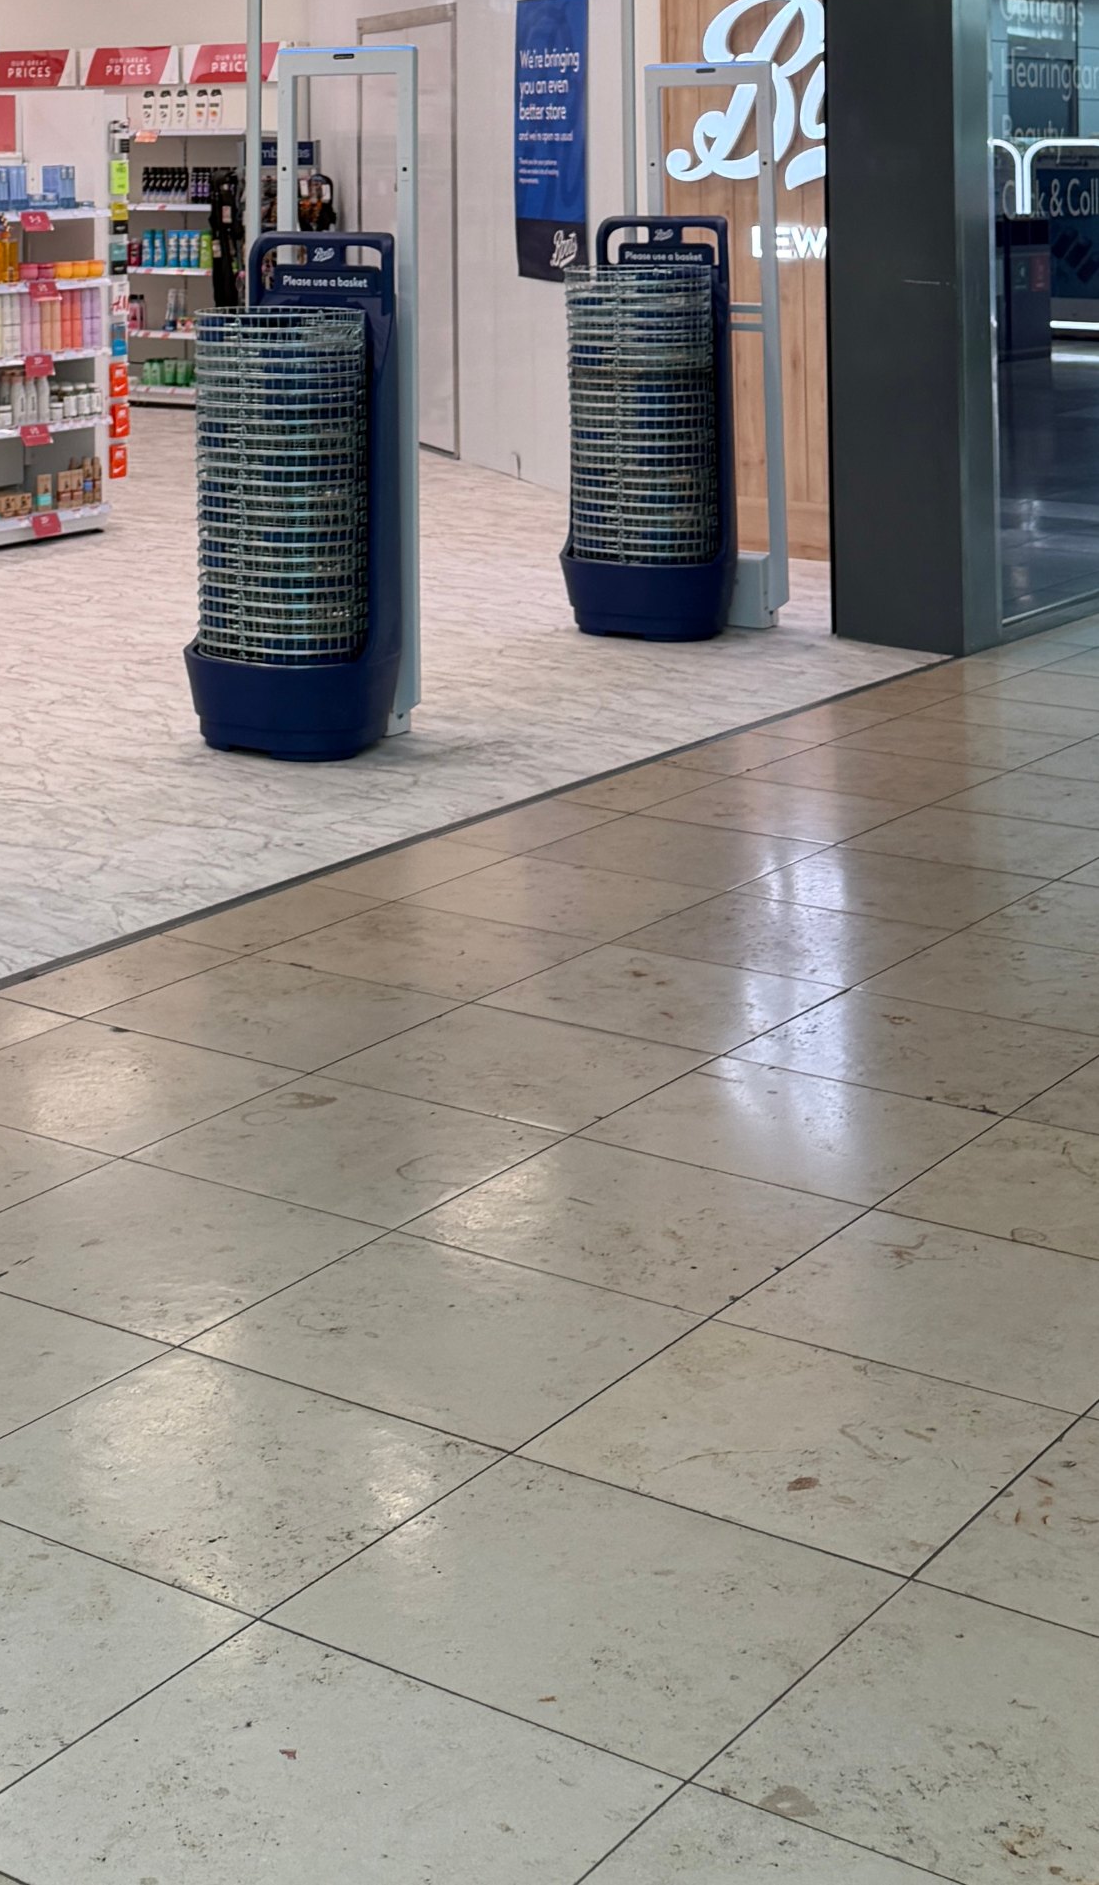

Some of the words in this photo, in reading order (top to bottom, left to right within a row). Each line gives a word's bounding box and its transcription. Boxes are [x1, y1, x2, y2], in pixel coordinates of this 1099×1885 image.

[211, 59, 247, 73] PRIC
[519, 48, 544, 69] We're
[544, 47, 580, 73] bringing
[7, 66, 52, 79] PRICES
[105, 63, 151, 76] PRICES
[518, 81, 535, 100] you
[535, 80, 547, 94] an
[548, 78, 569, 94] even
[518, 102, 544, 120] better
[544, 102, 567, 120] store
[624, 250, 651, 261] Please
[652, 253, 667, 261] use
[667, 253, 674, 261] a
[674, 252, 703, 262] basket
[282, 275, 312, 287] Please
[312, 279, 329, 287] use
[329, 279, 336, 287] a
[337, 277, 369, 288] basket
